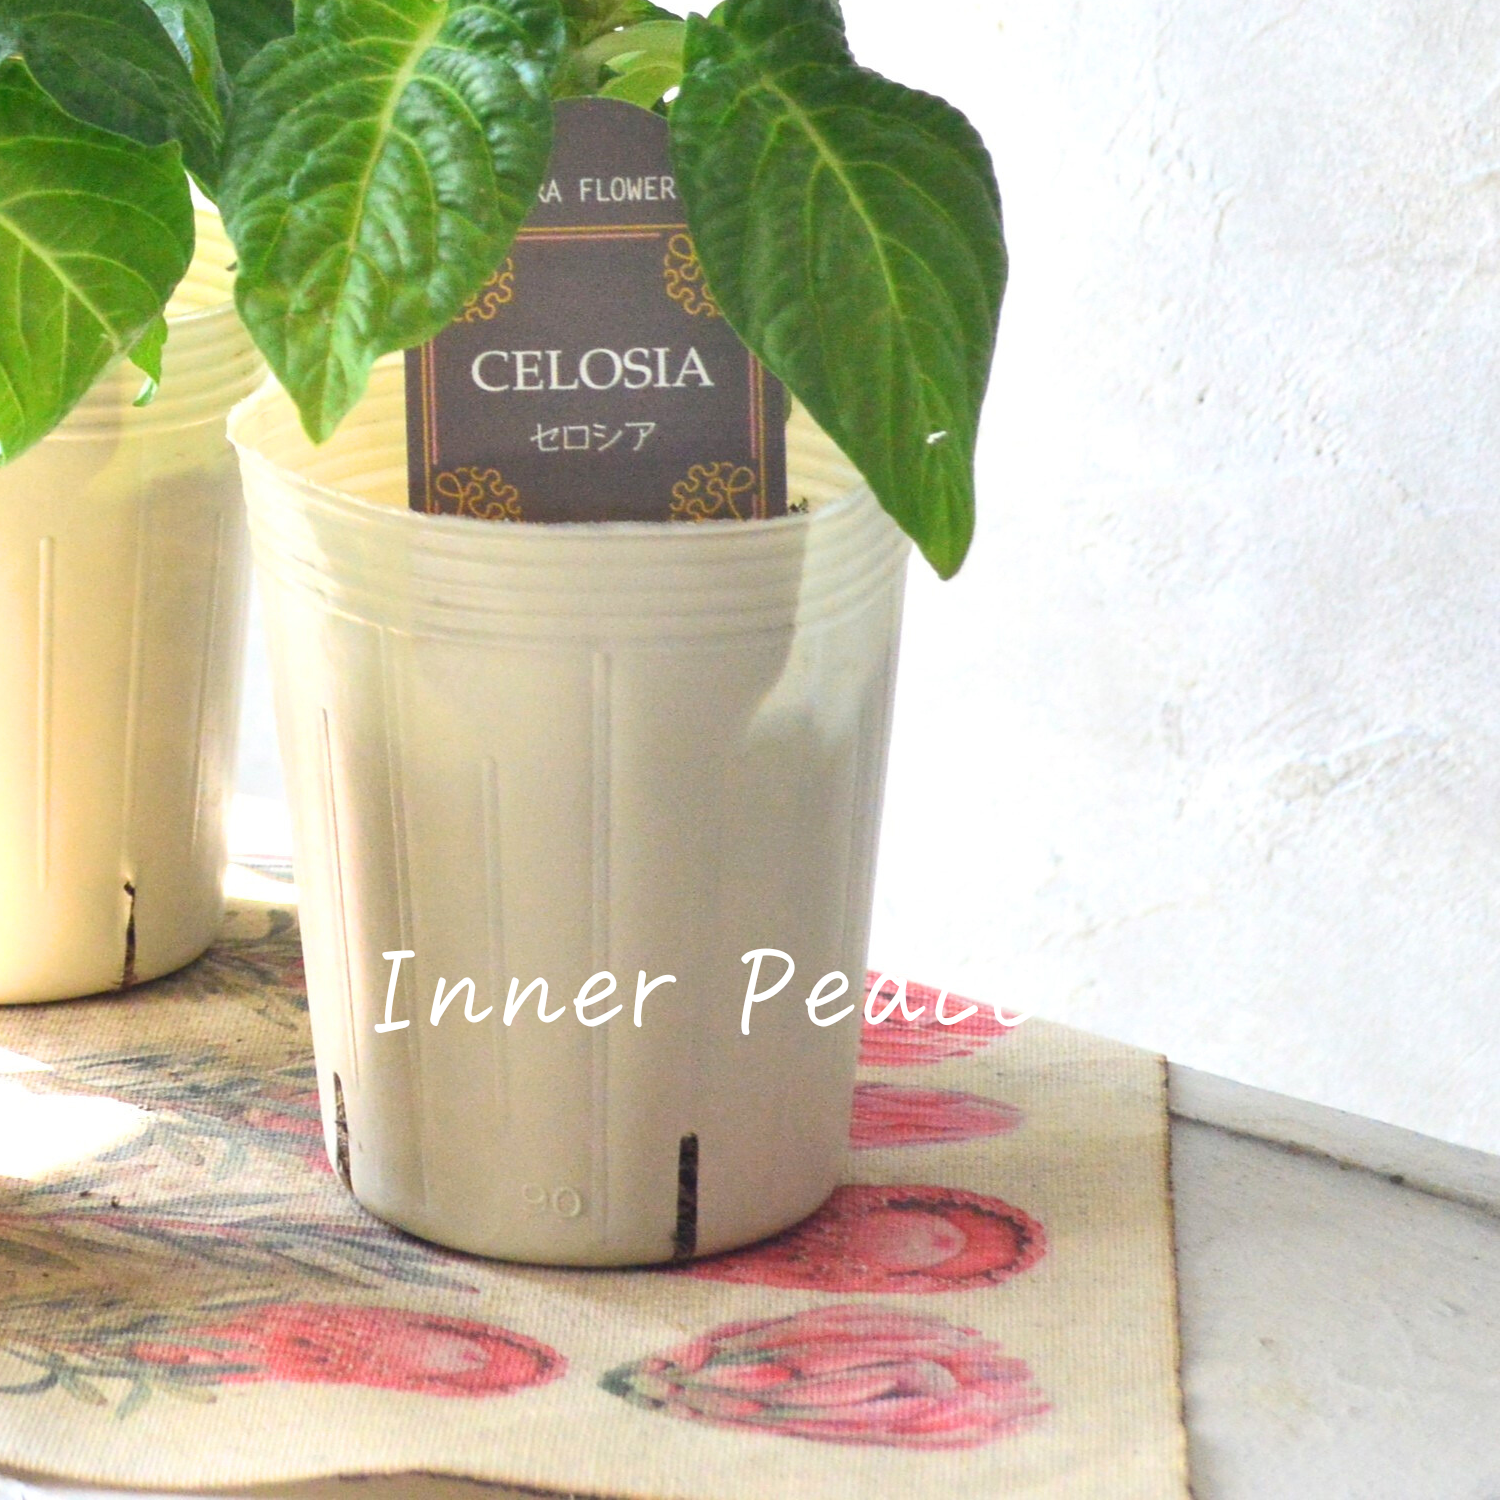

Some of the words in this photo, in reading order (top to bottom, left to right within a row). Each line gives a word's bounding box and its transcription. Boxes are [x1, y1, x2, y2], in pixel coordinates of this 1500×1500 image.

[579, 176, 676, 202] FLOWER
[471, 347, 714, 392] CELOSIA
[529, 421, 656, 452] セロシア
